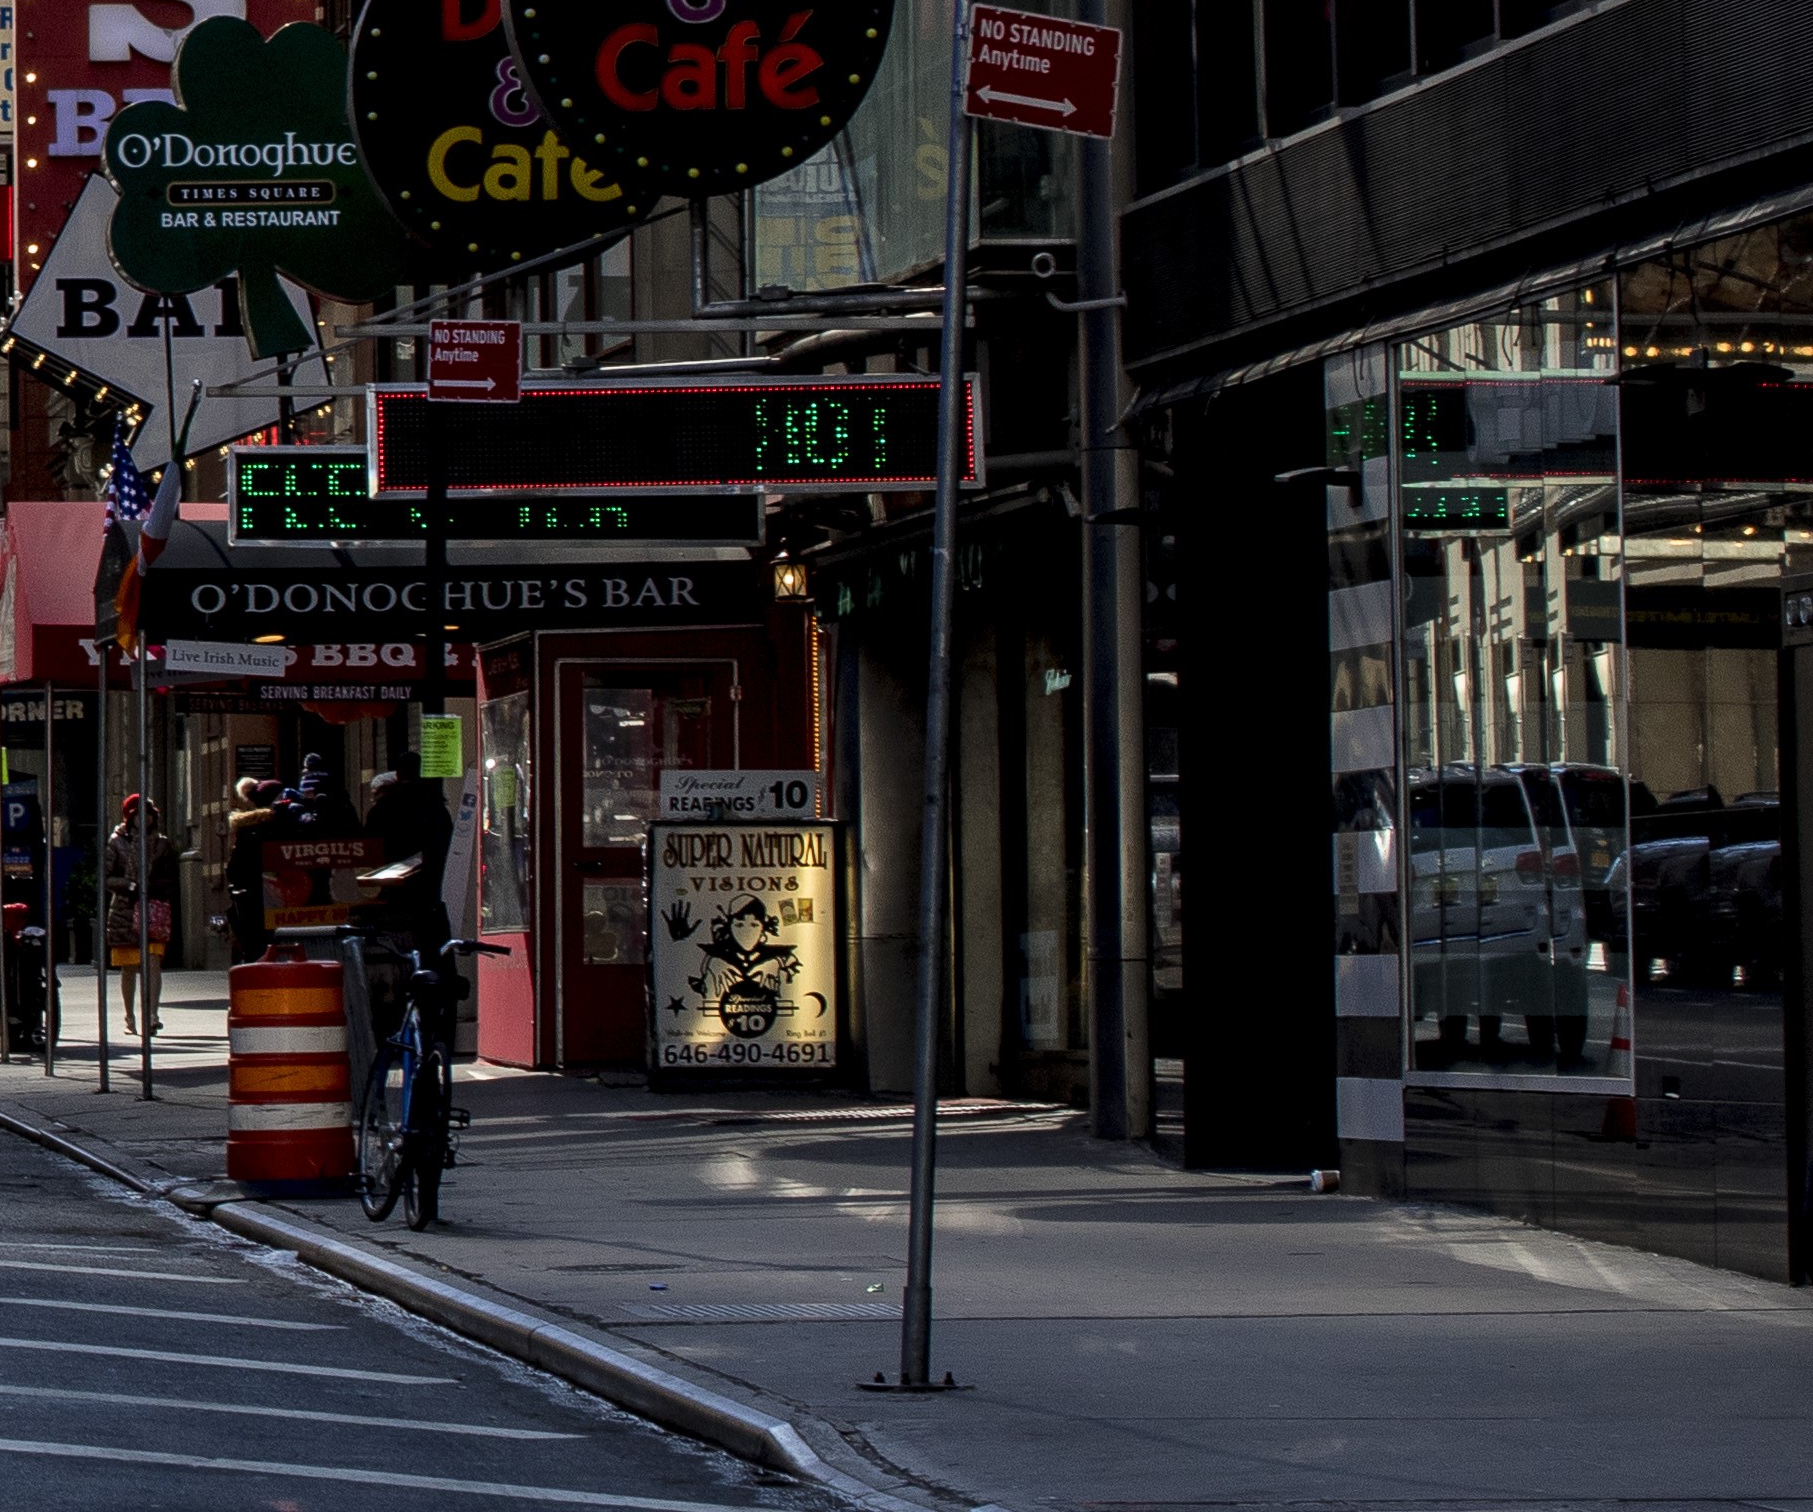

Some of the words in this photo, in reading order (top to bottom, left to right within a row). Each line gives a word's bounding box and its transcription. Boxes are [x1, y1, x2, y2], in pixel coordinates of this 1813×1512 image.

[980, 18, 1005, 41] NO
[1009, 24, 1095, 57] STANDING
[595, 10, 825, 112] Café
[978, 43, 1051, 76] Anytime
[181, 185, 240, 201] TIMES
[246, 183, 323, 200] SQUARE
[160, 212, 195, 229] BAR
[200, 211, 214, 229] &
[220, 209, 341, 228] RESTAURANT
[434, 330, 450, 345] NO
[452, 330, 506, 346] STANDING
[434, 347, 480, 365] Anytime
[602, 575, 700, 609] BAR
[172, 649, 200, 665] Live
[204, 651, 234, 667] Irish
[239, 652, 279, 669] Music
[311, 643, 416, 667] BBQ
[260, 686, 307, 699] SERVING
[313, 686, 375, 699] BREAKFAST
[381, 686, 412, 699] DAILY
[675, 774, 744, 793] Special
[9, 803, 25, 827] P
[280, 842, 365, 860] VIRGIL'S
[663, 832, 732, 869] SUPER
[741, 832, 827, 870] NATURAL
[690, 876, 800, 892] VISIONS
[725, 1003, 772, 1013] READINGS
[664, 1043, 830, 1064] 646-490-4691
